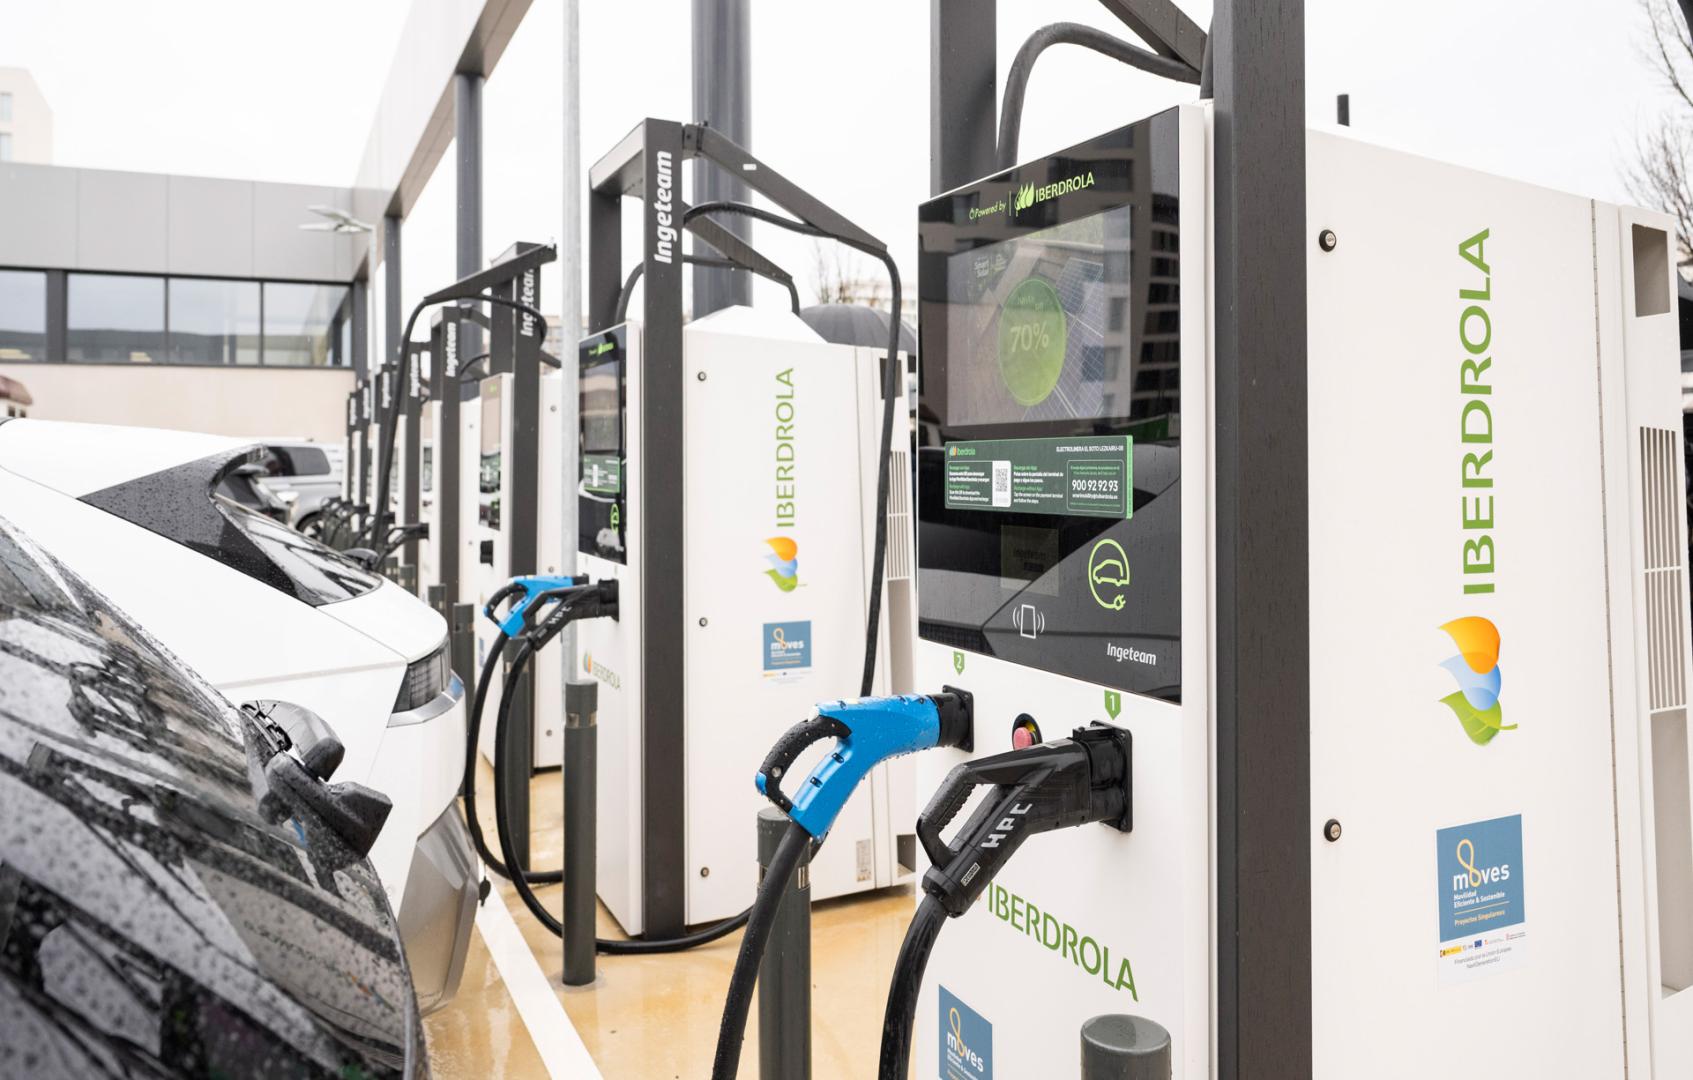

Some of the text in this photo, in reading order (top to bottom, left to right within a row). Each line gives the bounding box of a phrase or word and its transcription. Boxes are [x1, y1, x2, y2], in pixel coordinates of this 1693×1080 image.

[1035, 171, 1095, 204] IBERDROLA
[654, 150, 678, 264] Ingeteam
[999, 199, 1007, 214] by
[445, 322, 459, 377] Ingeteam
[1010, 322, 1049, 353] 70%
[1459, 228, 1495, 595] IBERDROLA
[776, 367, 795, 527] IBERDROLA
[1072, 479, 1119, 492] 900 92 92 93
[956, 656, 962, 669] 2
[1107, 642, 1157, 665] Ingeteam
[1110, 694, 1115, 711] 1
[981, 803, 1033, 848] HPC
[1453, 850, 1510, 890] moves
[988, 880, 1139, 1002] IBERDROLA
